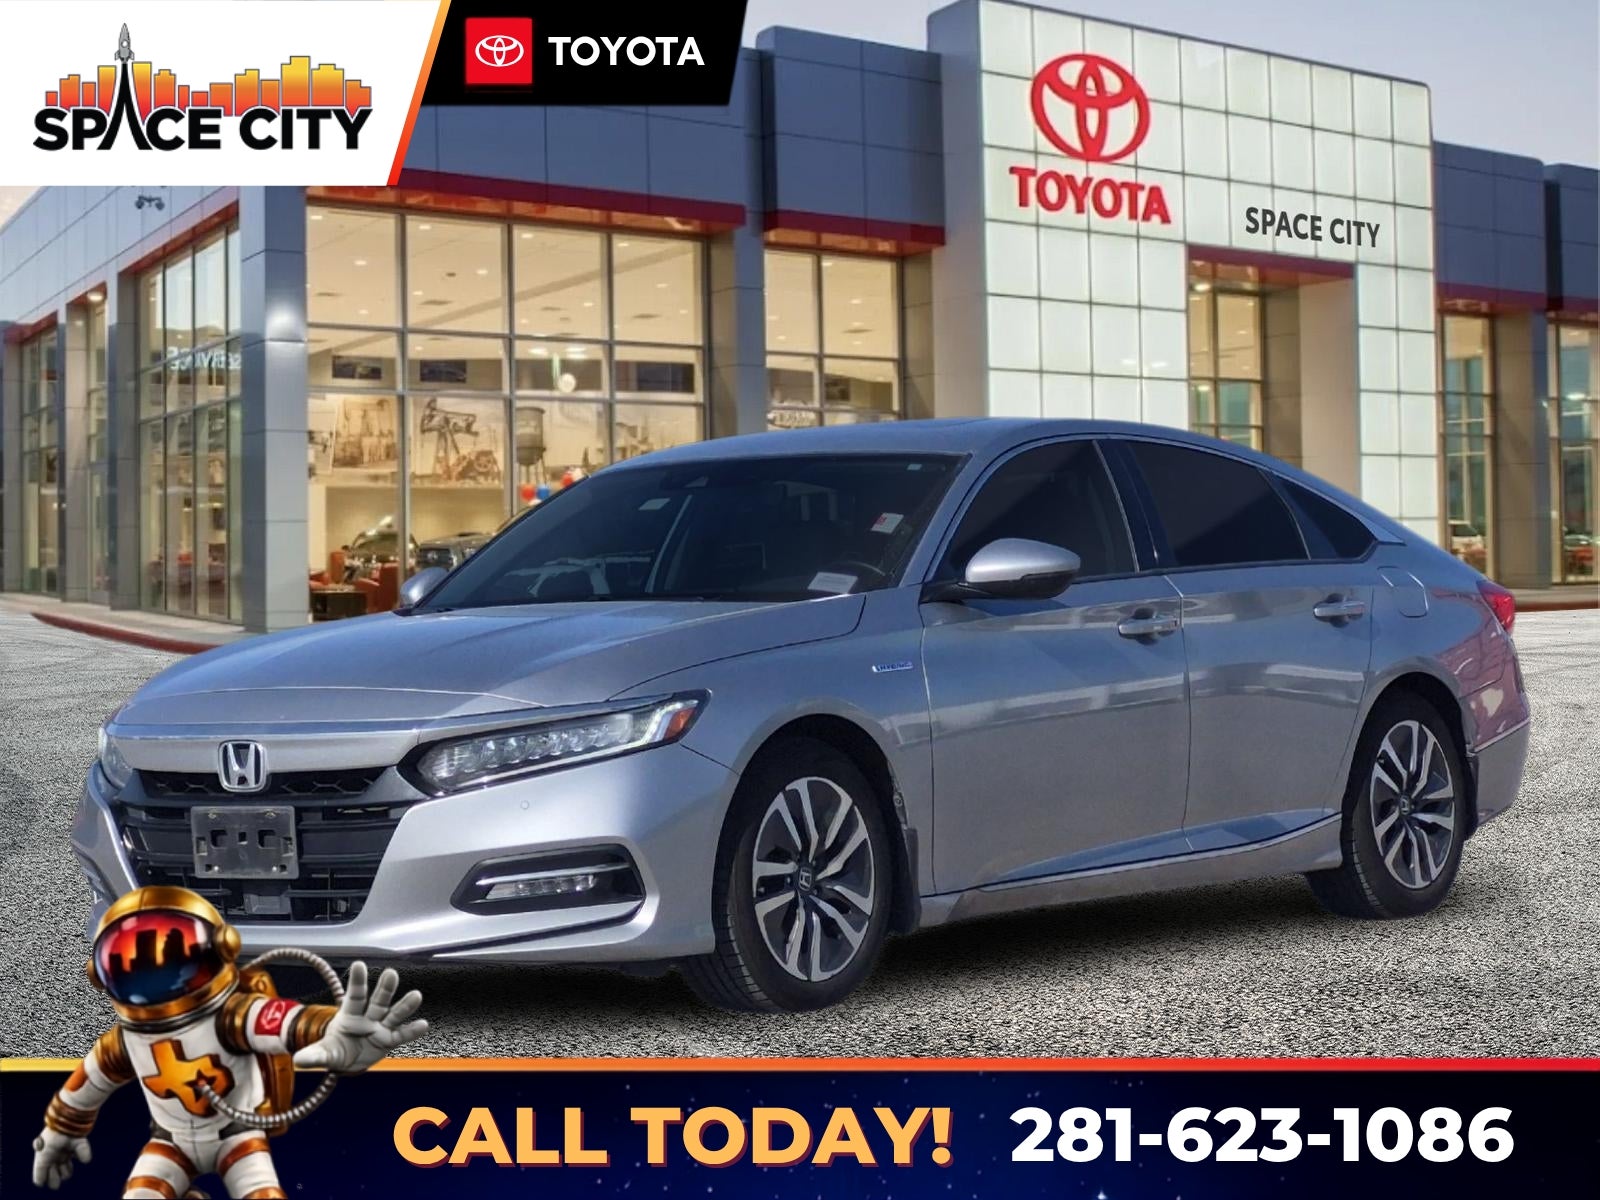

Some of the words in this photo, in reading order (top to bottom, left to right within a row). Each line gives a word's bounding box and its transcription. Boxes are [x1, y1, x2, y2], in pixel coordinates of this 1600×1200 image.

[1009, 167, 1171, 224] TOYOTA
[1245, 207, 1322, 241] SPACE
[1330, 218, 1380, 248] CITY
